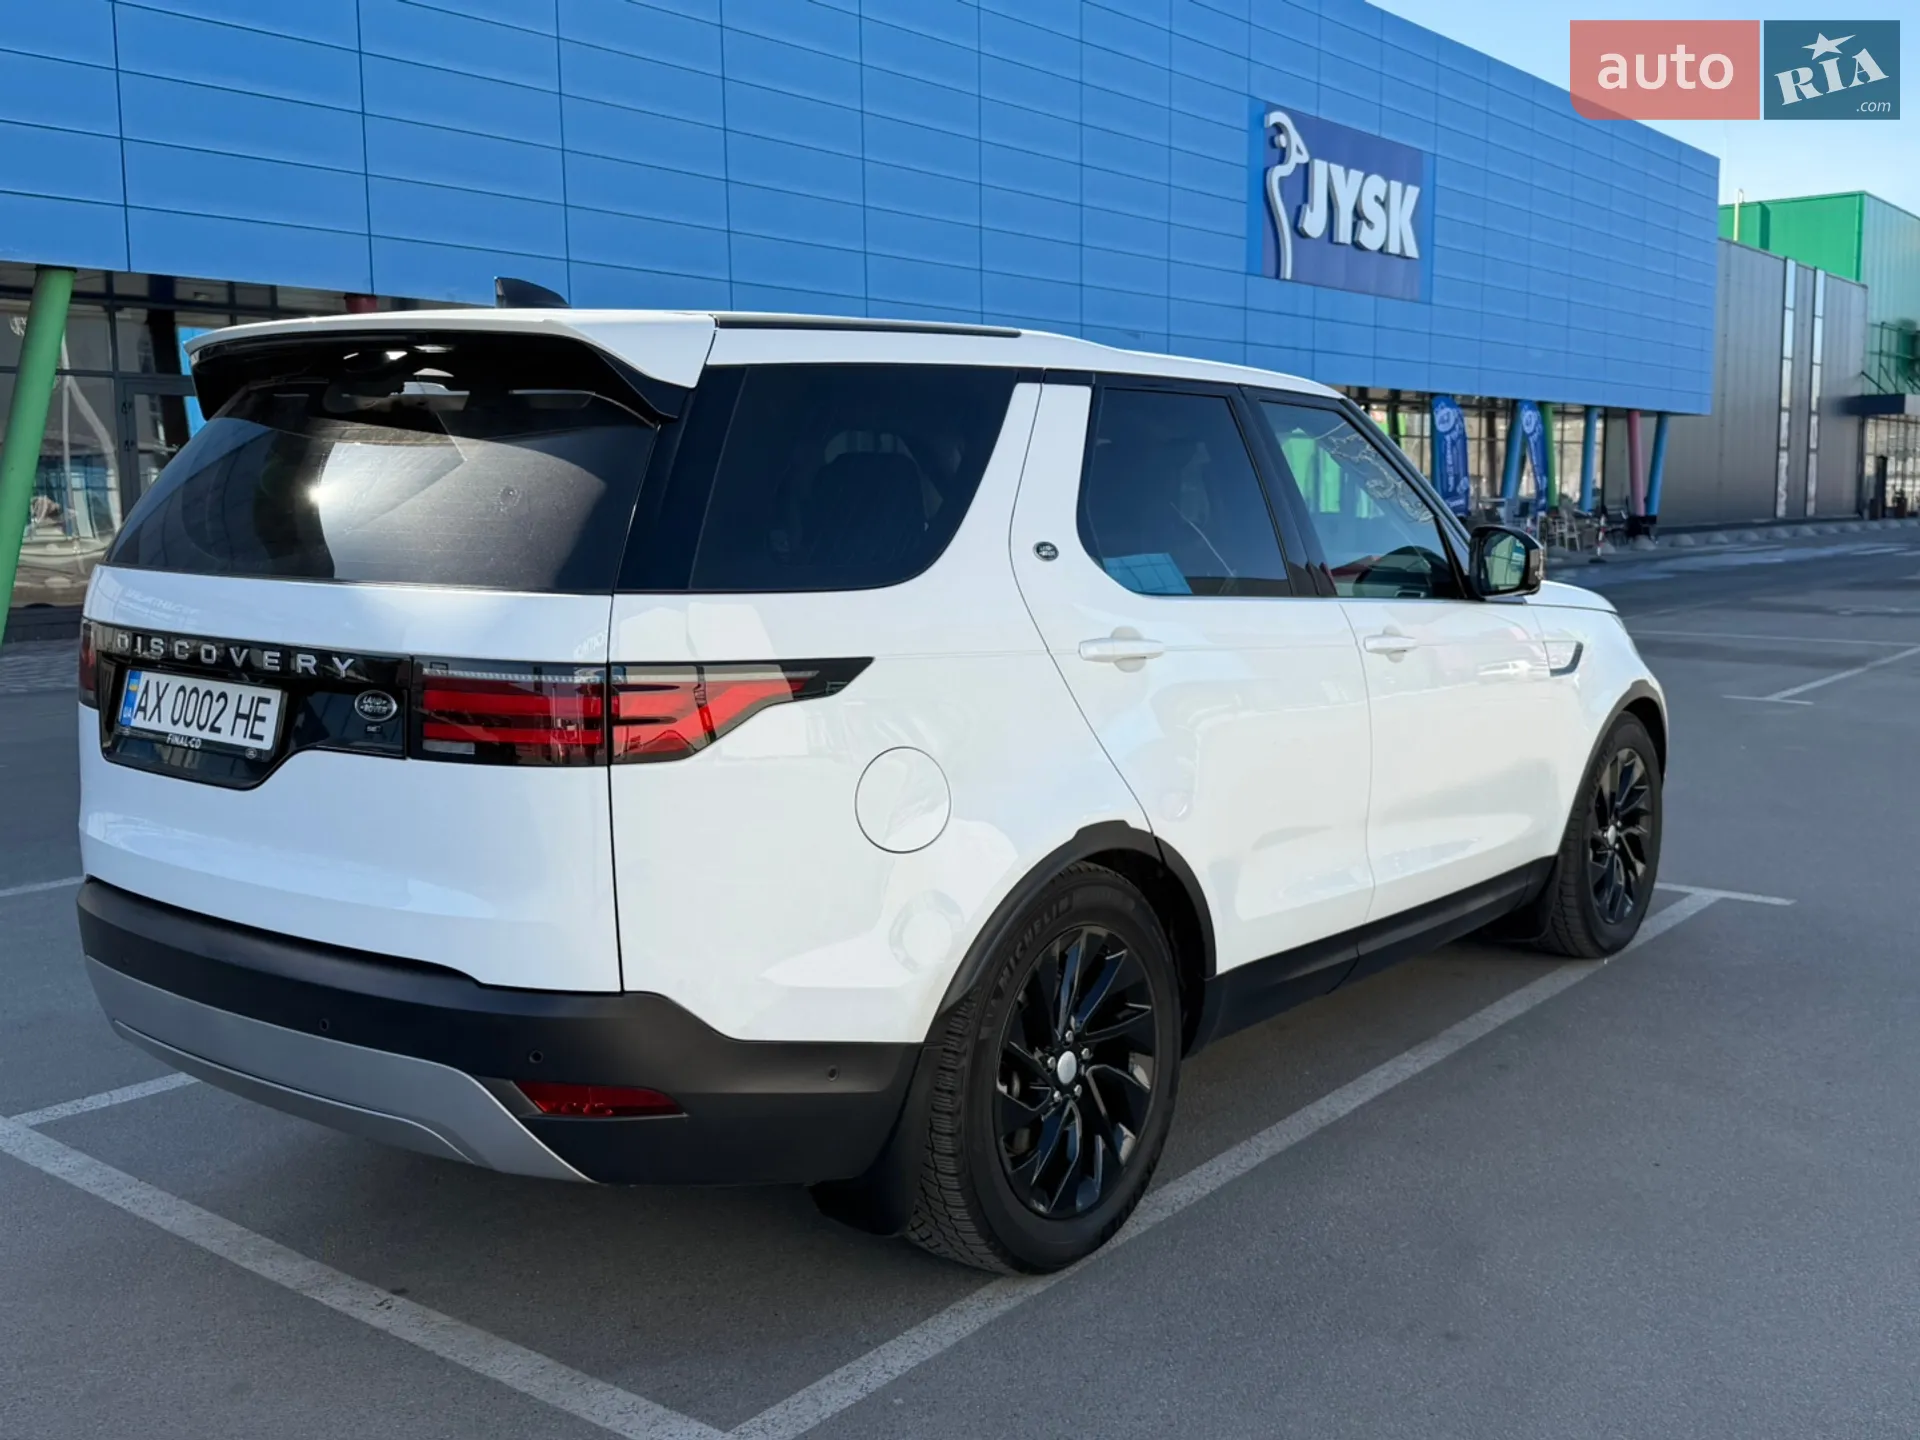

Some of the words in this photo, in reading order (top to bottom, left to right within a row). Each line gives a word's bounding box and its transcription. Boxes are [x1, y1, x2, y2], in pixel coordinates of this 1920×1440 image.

[1298, 158, 1420, 259] JYSK
[117, 633, 355, 678] DISCOVERY
[133, 679, 170, 723] AX
[170, 685, 229, 734] 0002
[230, 693, 272, 742] HE
